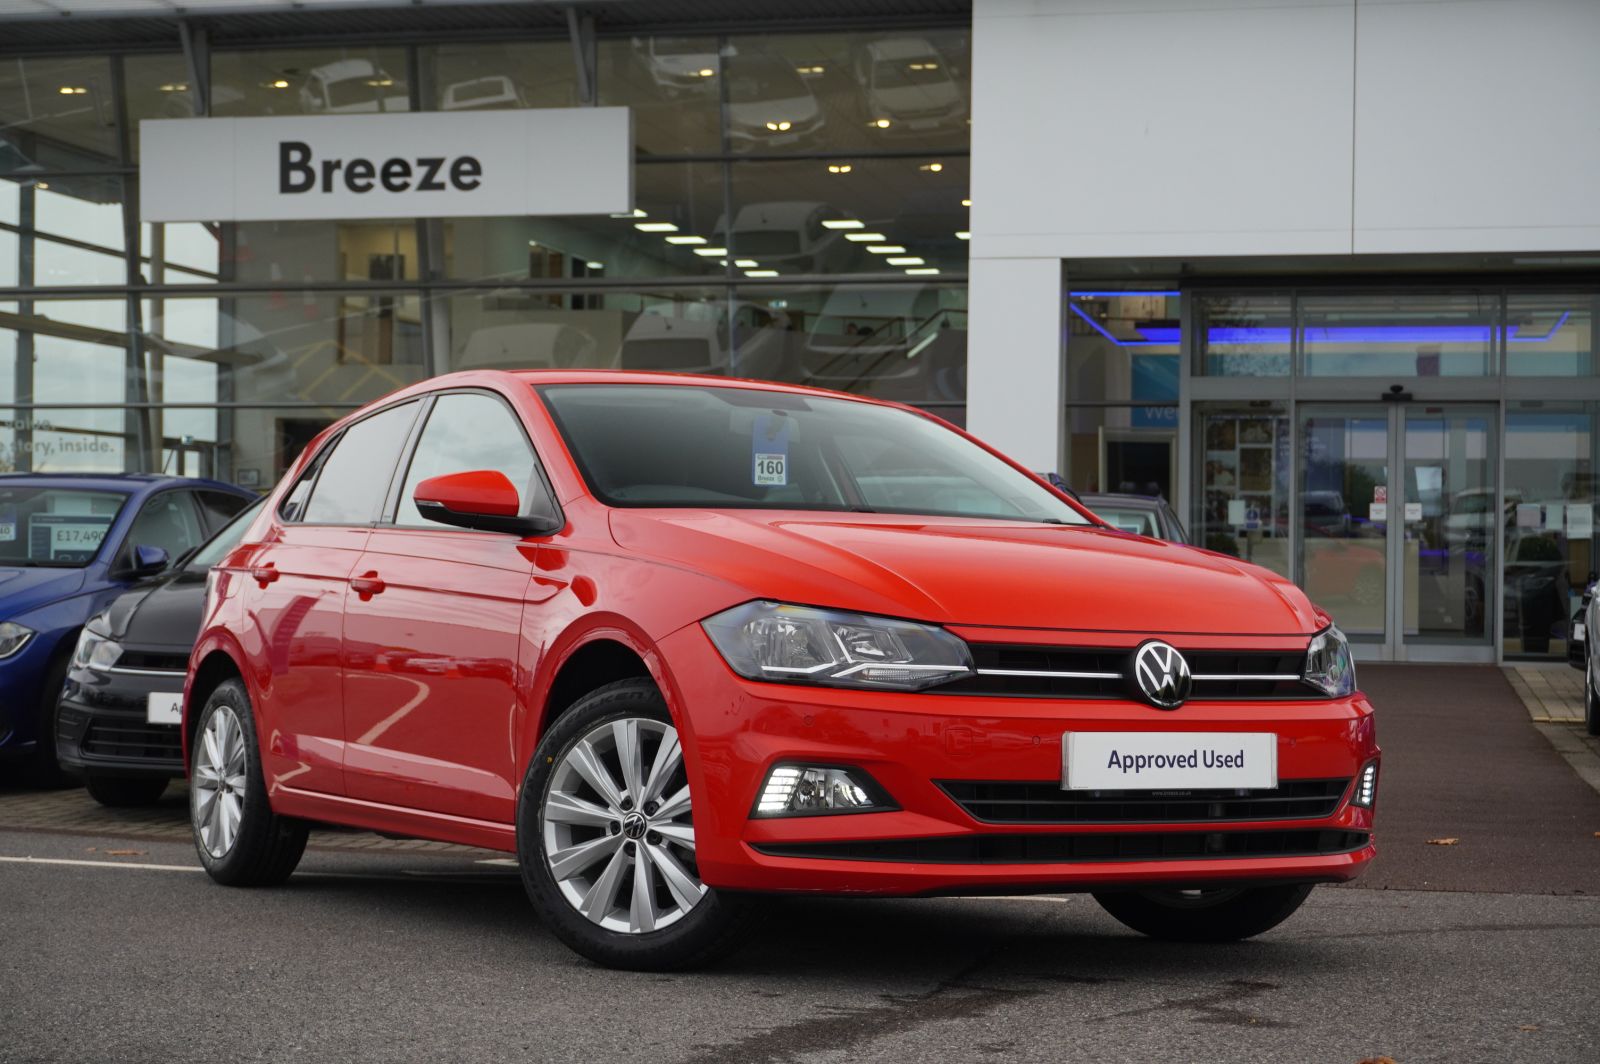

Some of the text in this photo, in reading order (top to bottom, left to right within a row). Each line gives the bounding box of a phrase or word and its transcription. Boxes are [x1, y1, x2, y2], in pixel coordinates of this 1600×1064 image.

[279, 141, 482, 194] Breeze
[59, 436, 115, 453] inside.
[757, 460, 783, 474] 160
[1107, 749, 1244, 773] Approved Used
